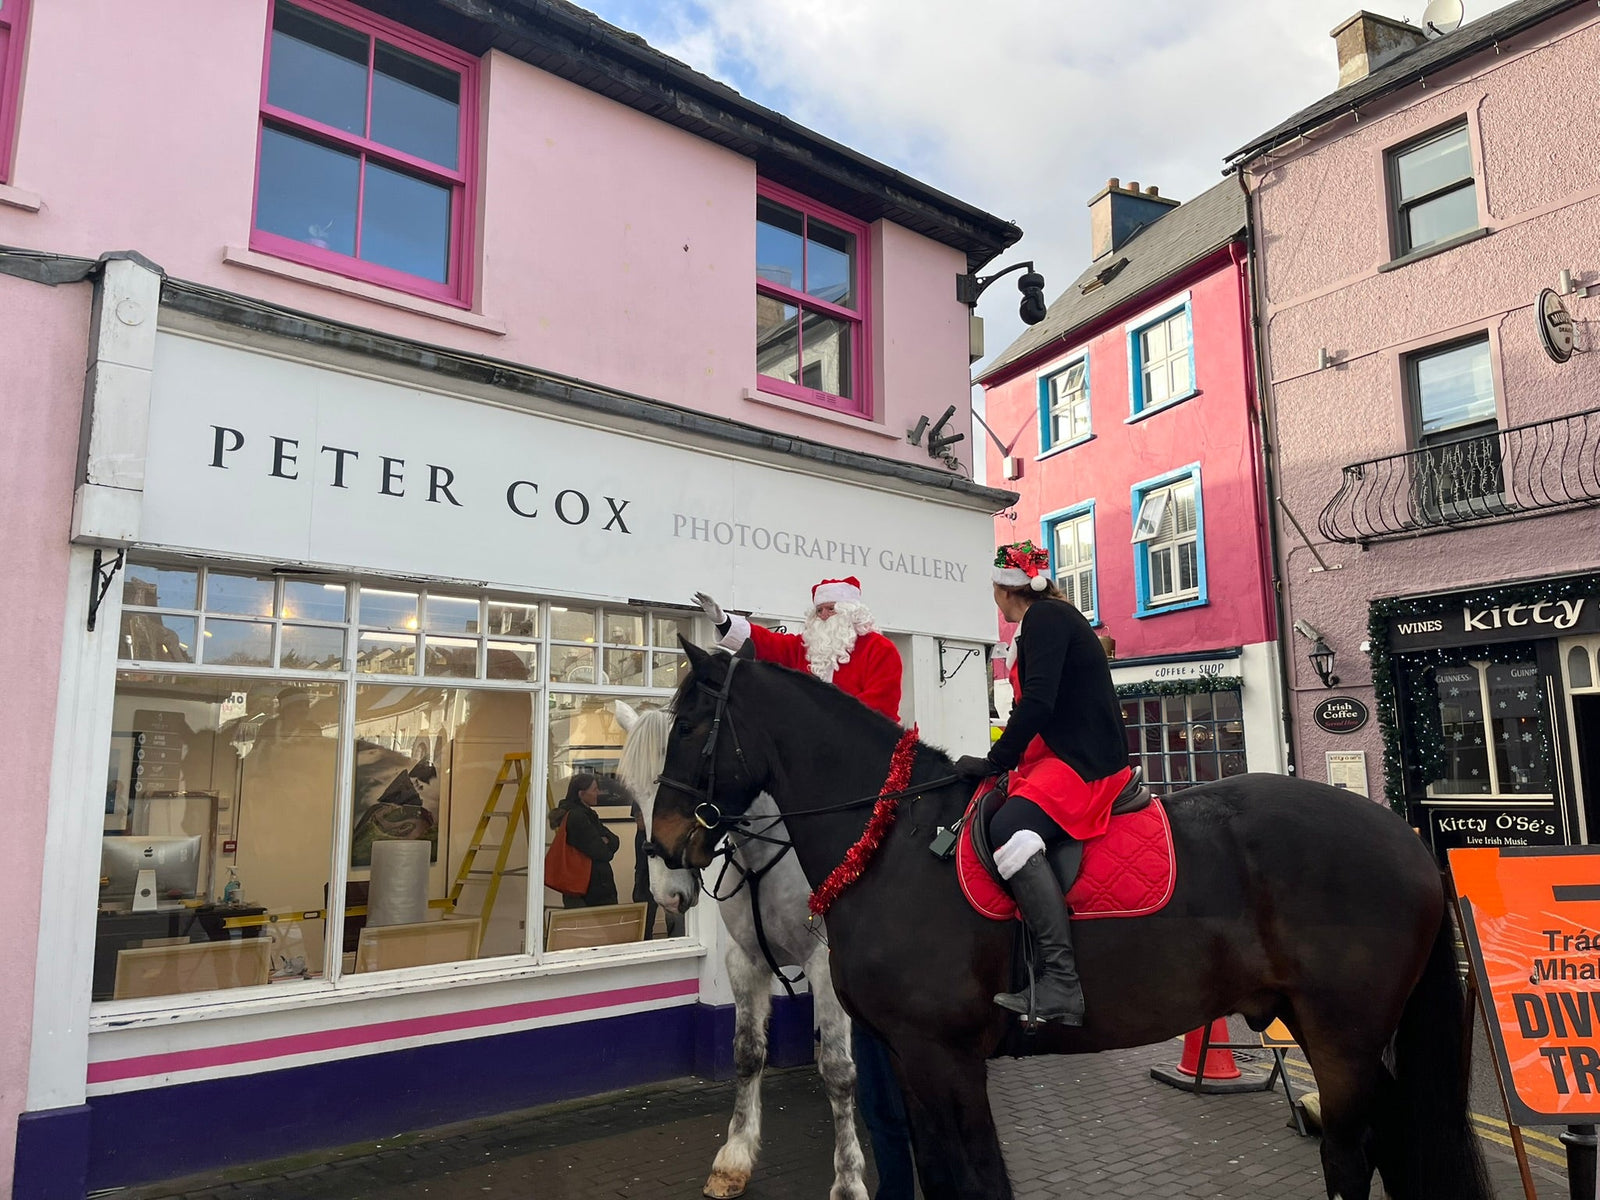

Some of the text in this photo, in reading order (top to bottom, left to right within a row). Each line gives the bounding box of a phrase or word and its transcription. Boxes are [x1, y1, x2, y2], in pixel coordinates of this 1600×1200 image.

[208, 425, 632, 535] PETER COX
[672, 513, 968, 583] PHOTOGRAPHY GALLERY
[1398, 620, 1443, 635] WINES
[1155, 666, 1186, 677] COFFEE
[1199, 662, 1225, 674] SHOP
[1435, 673, 1470, 683] GUINNESS
[1327, 702, 1352, 711] Irish
[1323, 710, 1358, 719] Coffee
[1438, 817, 1487, 832] Kitty
[1467, 836, 1528, 846] Live Irish Music
